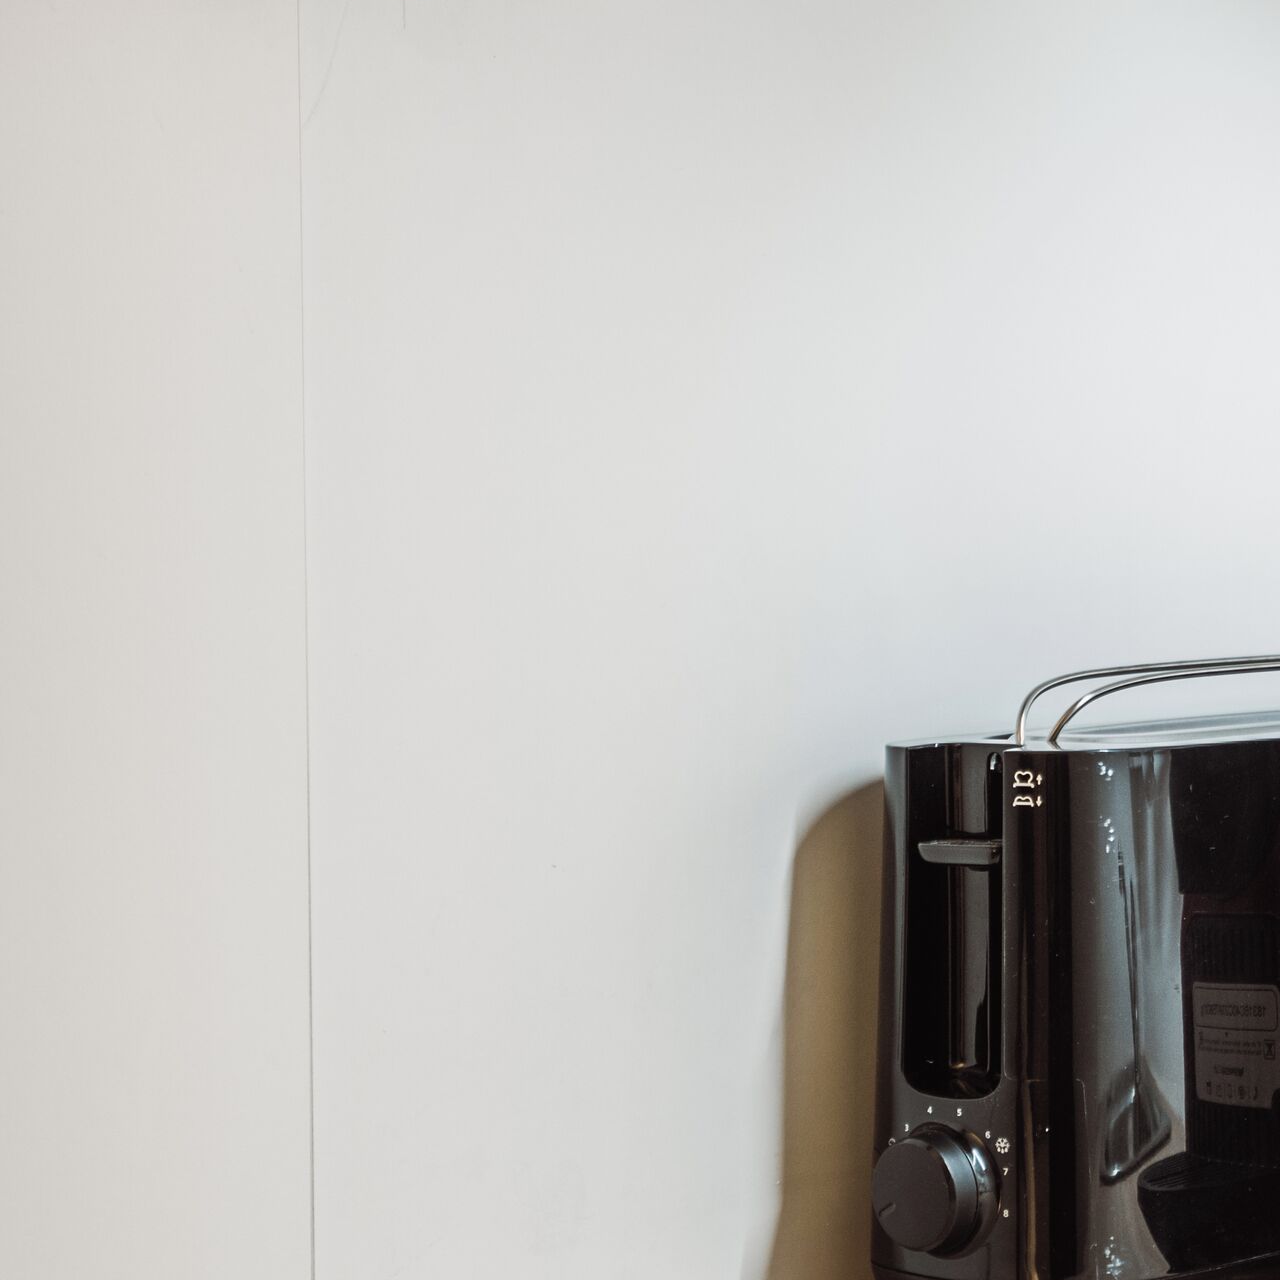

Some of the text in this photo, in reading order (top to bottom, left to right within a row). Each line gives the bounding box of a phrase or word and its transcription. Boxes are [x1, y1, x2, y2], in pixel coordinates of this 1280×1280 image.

[926, 1105, 933, 1114] 4
[956, 1108, 962, 1117] 5
[984, 1130, 991, 1139] 6
[1003, 1167, 1009, 1176] 7
[1003, 1209, 1009, 1218] 8
